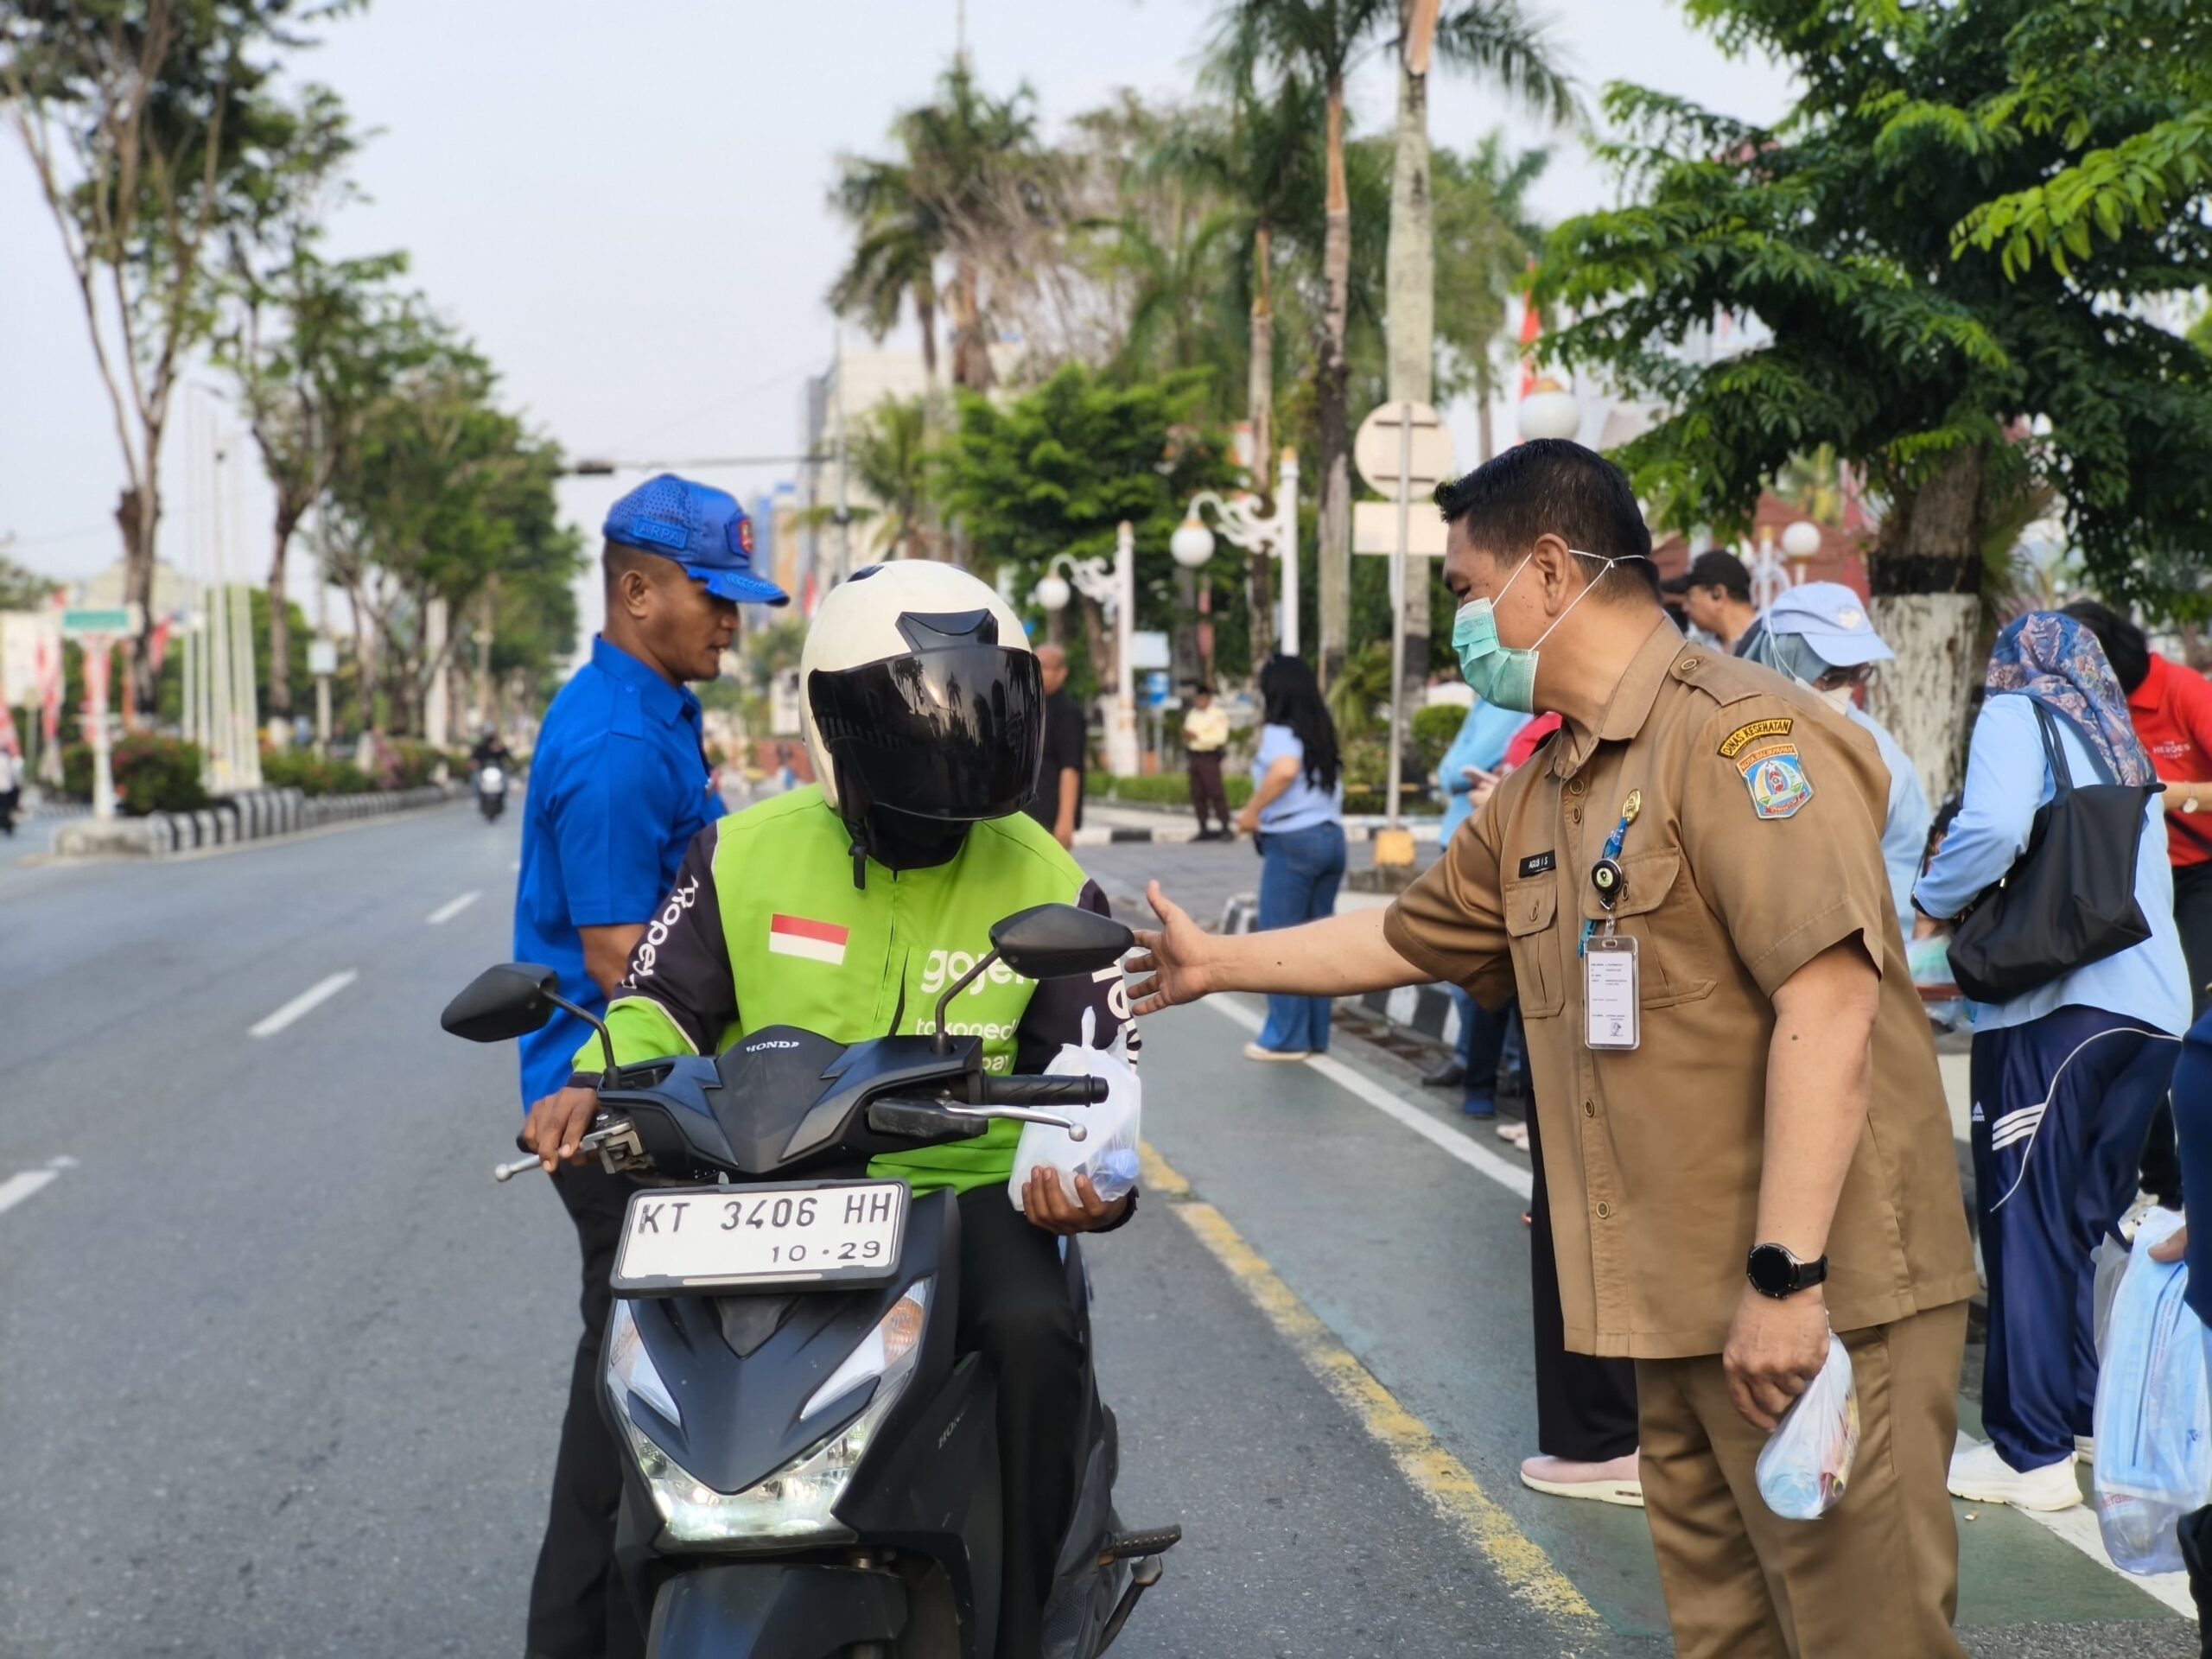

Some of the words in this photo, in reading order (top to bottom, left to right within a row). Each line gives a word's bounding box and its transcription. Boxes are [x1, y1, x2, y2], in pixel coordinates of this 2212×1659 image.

[639, 524, 680, 543] ARPA
[1722, 733, 1745, 754] DINAS
[1742, 721, 1789, 739] KESEHATAN
[1740, 756, 1755, 770] KOTA
[1755, 746, 1794, 760] BALIKPAPAN
[920, 949, 1039, 995] goje
[638, 1202, 691, 1234] KT
[720, 1197, 818, 1231] 3406
[843, 1192, 893, 1224] HH
